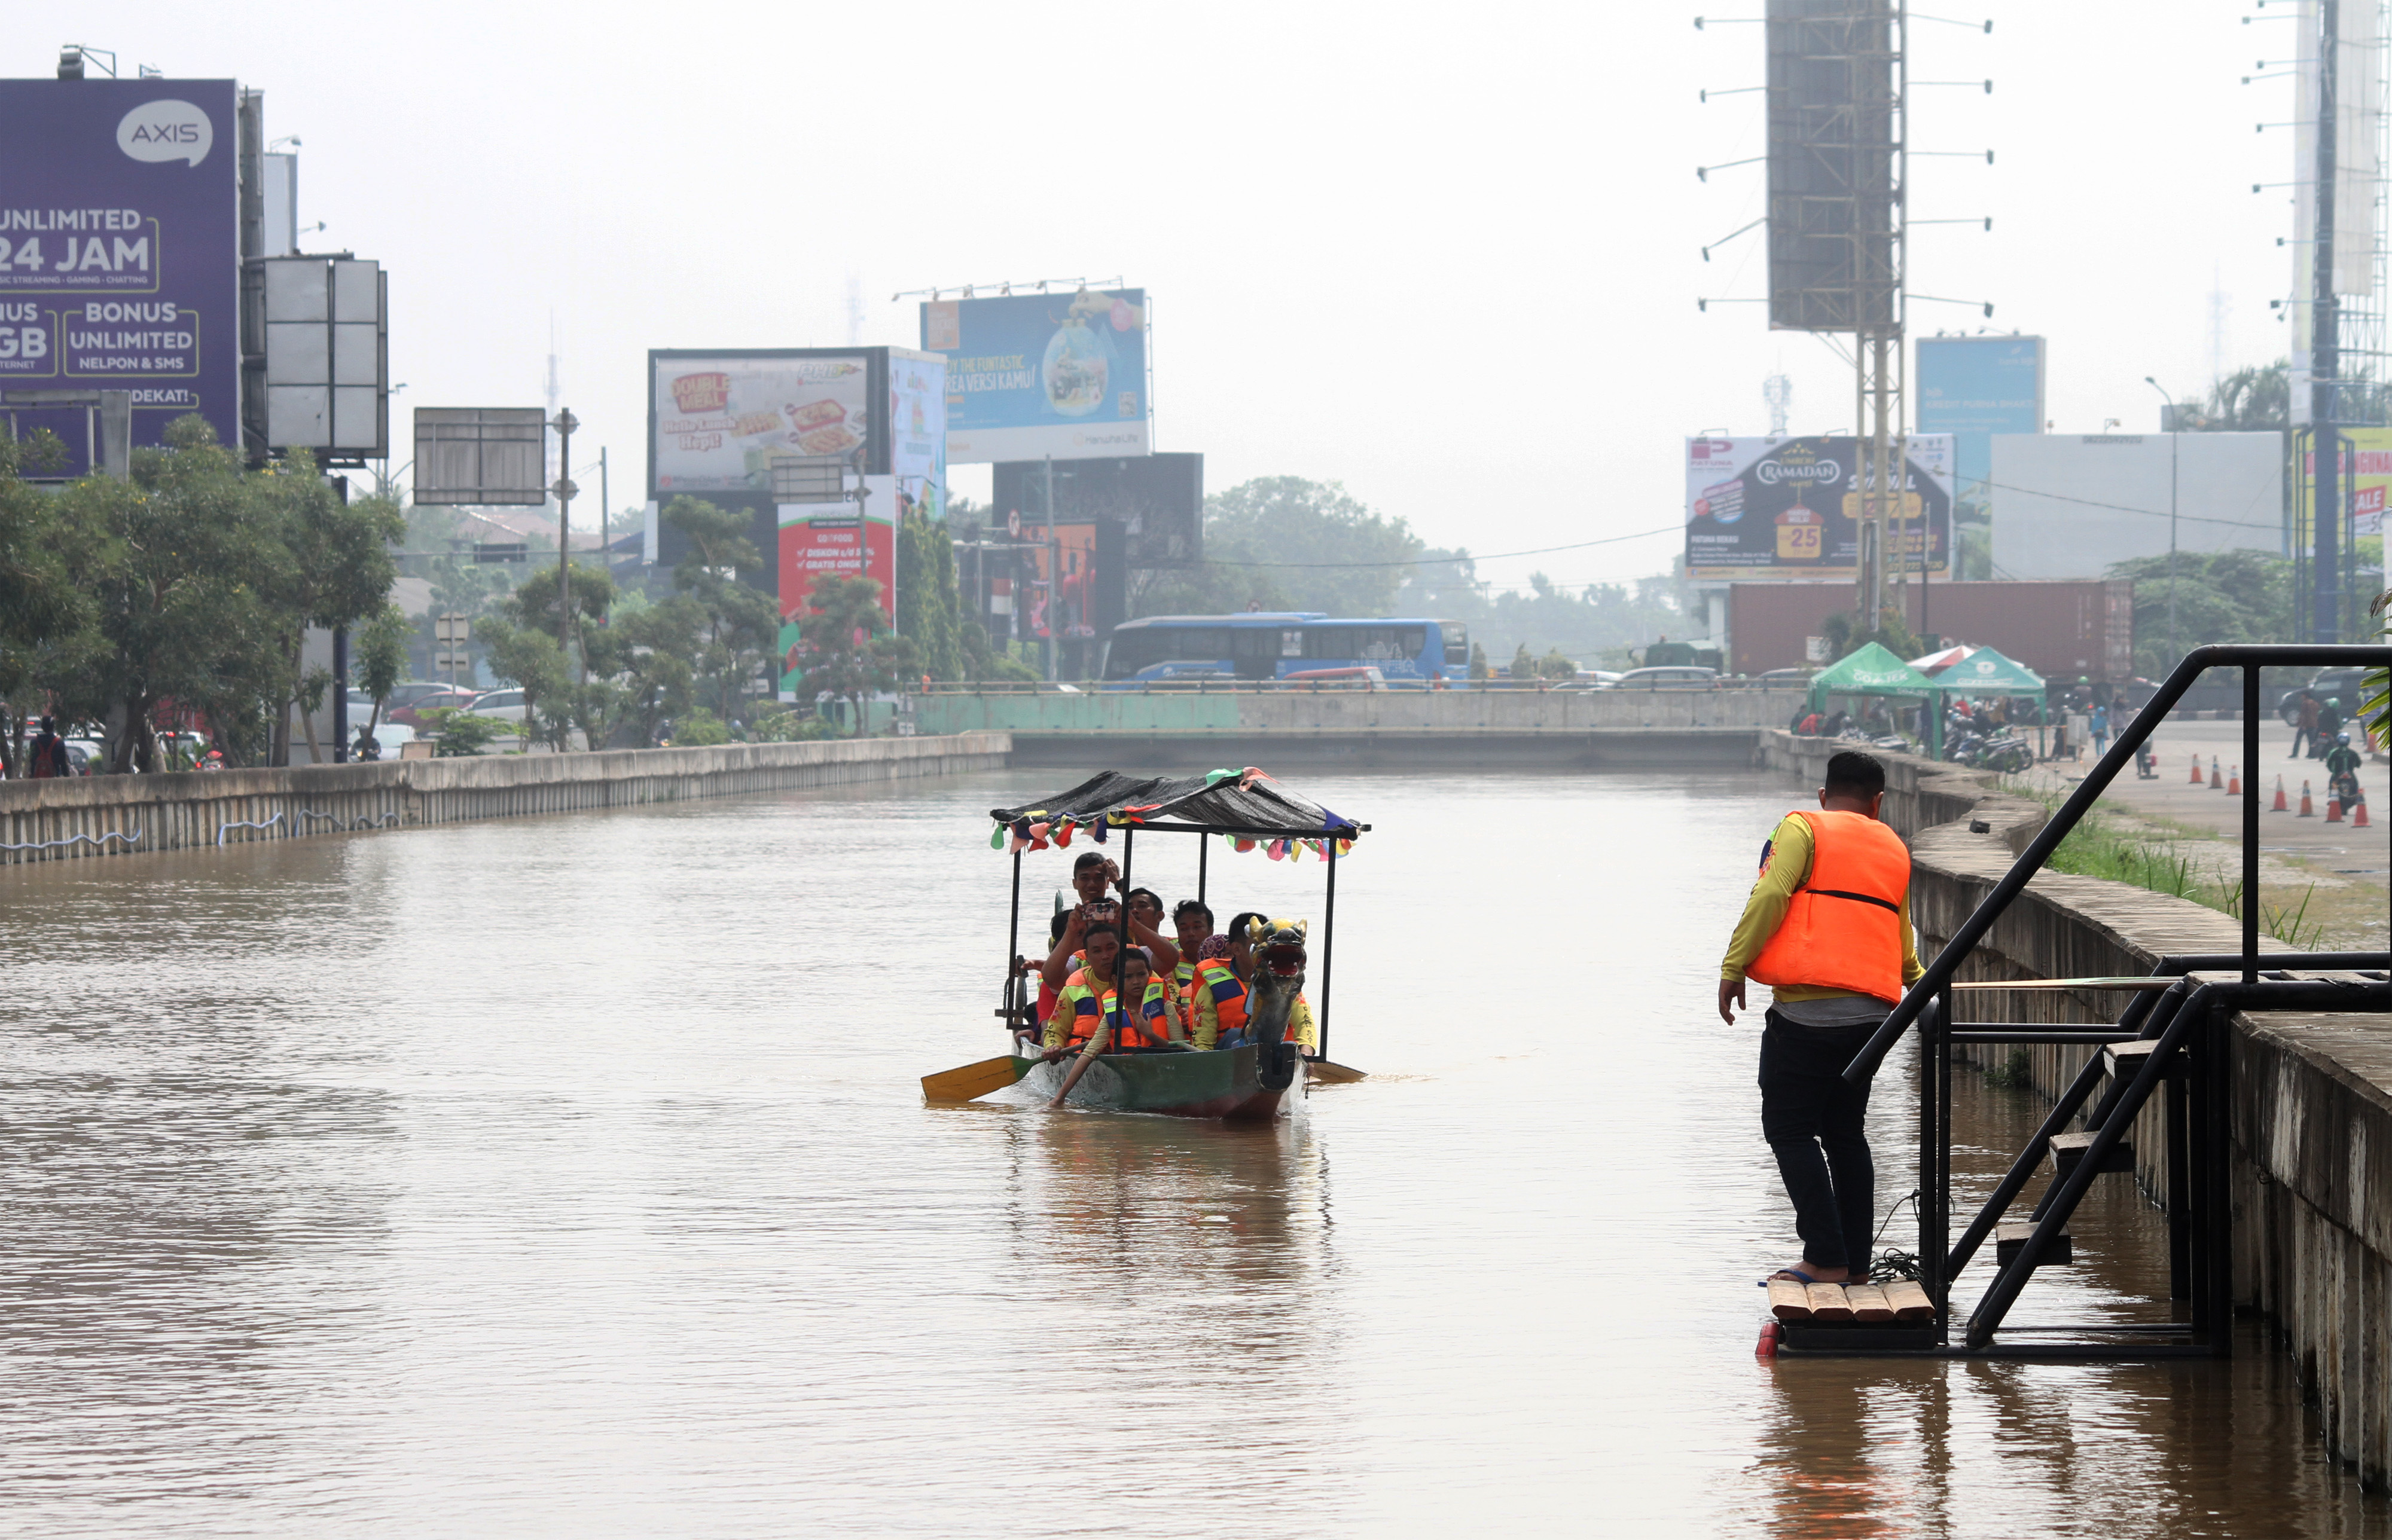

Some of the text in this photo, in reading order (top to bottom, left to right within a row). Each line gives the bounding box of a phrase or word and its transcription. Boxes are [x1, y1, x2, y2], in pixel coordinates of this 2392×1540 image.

[131, 124, 199, 143] AXIS
[0, 209, 141, 231] UNLIMITED
[55, 237, 148, 272] JAM
[86, 302, 177, 322] BONUS
[70, 332, 193, 350] UNLIMITED
[0, 360, 35, 369] TERNET
[80, 357, 184, 370] NELPON & SMS
[797, 363, 843, 379] PHD
[960, 356, 976, 372] THE
[977, 354, 1024, 371] FUNTASTIC
[671, 374, 732, 396] DOUBLE
[966, 372, 996, 393] VERSI
[103, 389, 188, 402] DEKAT!
[680, 393, 726, 411] MEAL
[663, 416, 737, 434] Hello Lunch
[679, 433, 722, 452] Hepi!
[1765, 465, 1834, 479] RAMADAN
[2354, 490, 2383, 512] ALE
[1791, 528, 1818, 547] 25
[807, 548, 839, 557] DISKON
[856, 548, 875, 556] 5%
[806, 560, 835, 569] GRATIS
